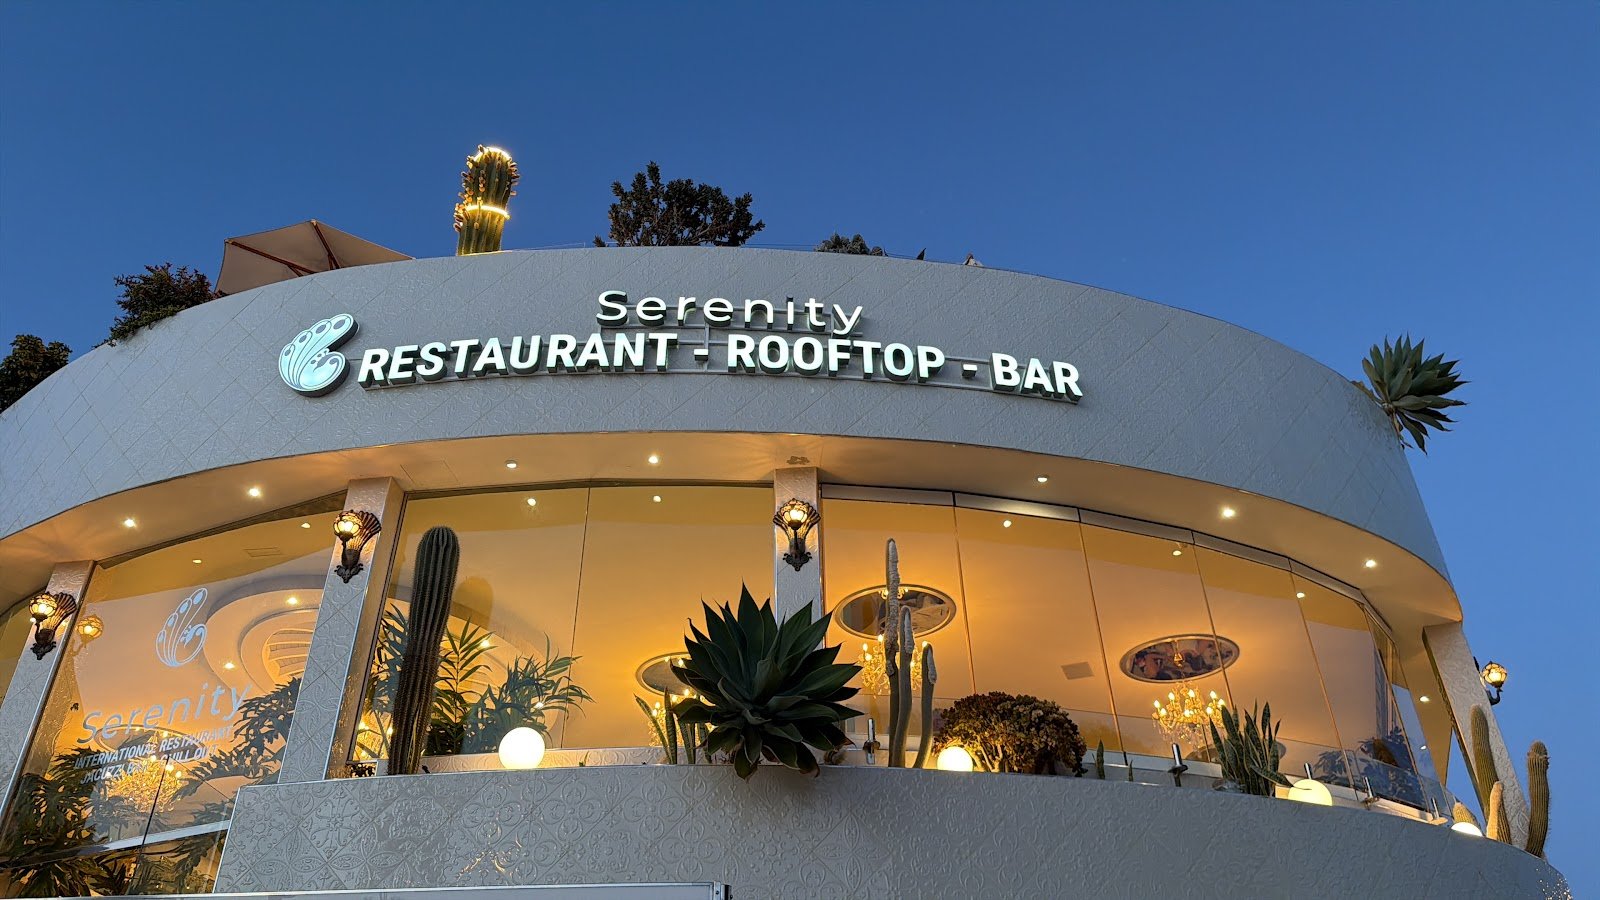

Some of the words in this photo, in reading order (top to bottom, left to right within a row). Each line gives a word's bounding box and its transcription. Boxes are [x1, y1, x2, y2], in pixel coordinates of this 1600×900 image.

[596, 290, 863, 336] Serenity
[358, 332, 678, 386] RESTAURANT
[727, 333, 945, 382] ROOFTOP
[990, 352, 1083, 401] BAR
[76, 682, 252, 744] Serenity
[74, 743, 157, 769] INTERNATIONAL
[159, 726, 234, 752] RESTAURANT
